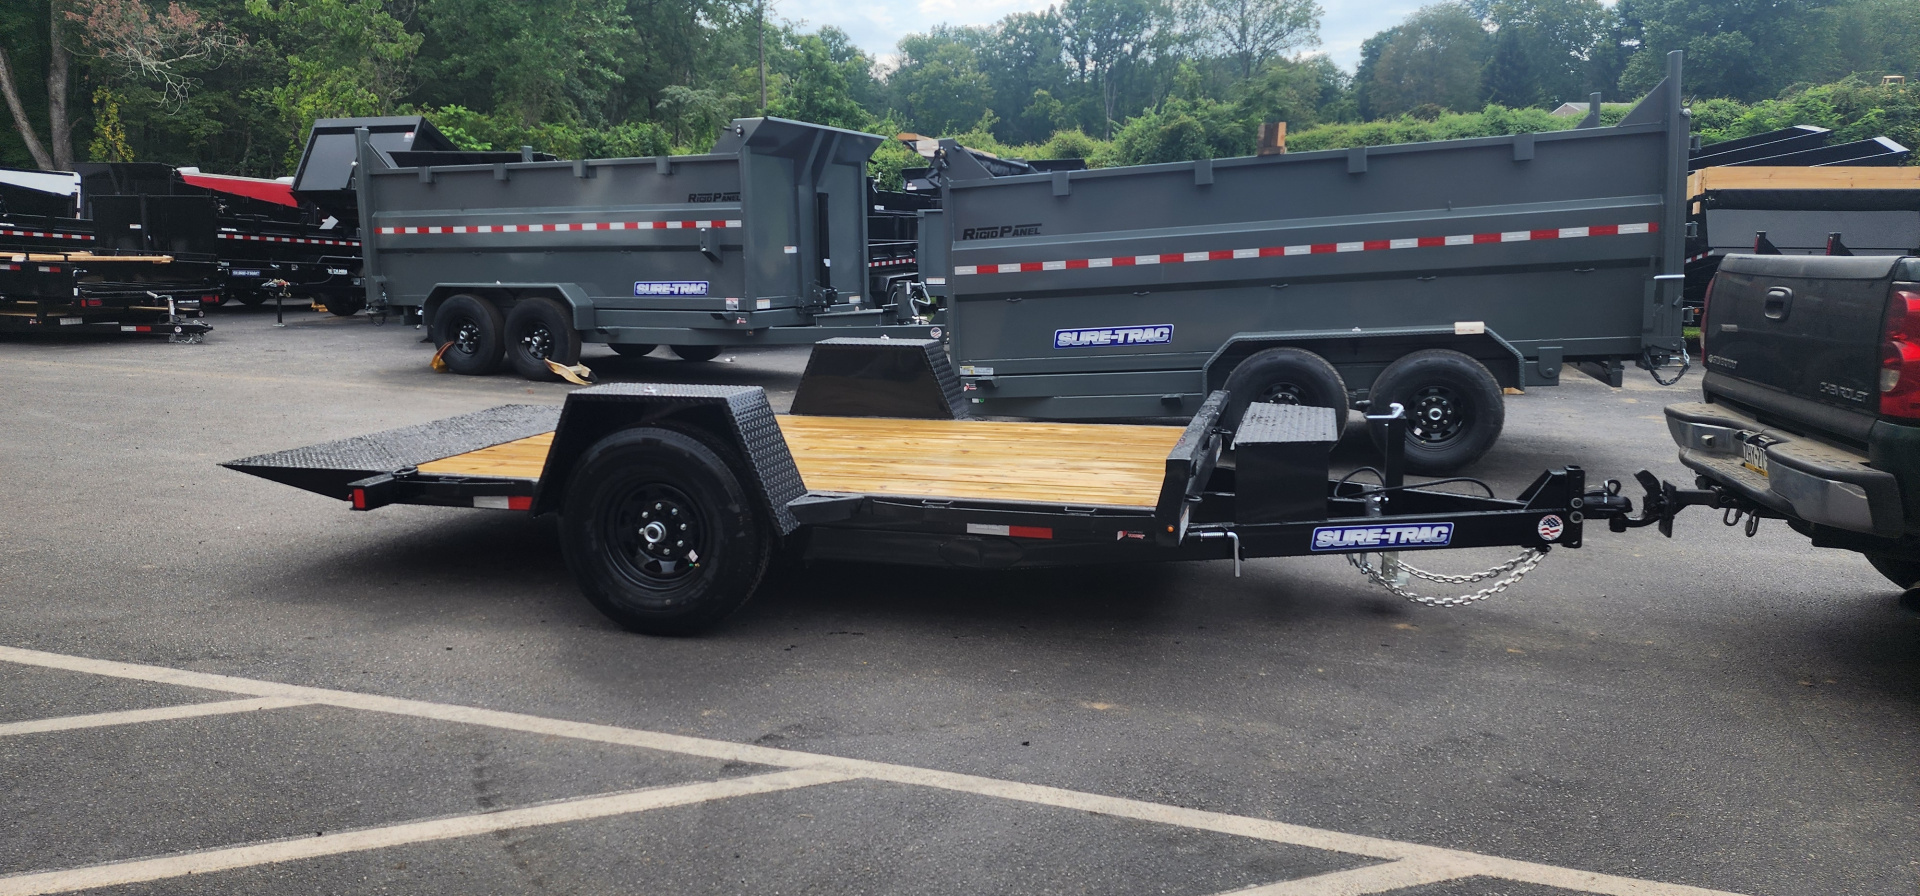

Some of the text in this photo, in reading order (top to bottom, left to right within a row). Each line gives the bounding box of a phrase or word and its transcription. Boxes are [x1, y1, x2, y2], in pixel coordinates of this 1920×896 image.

[963, 223, 1042, 240] RIGID PANEL
[636, 283, 707, 295] SURE-TRAC
[1057, 327, 1170, 347] SURE-TRAC
[1315, 526, 1449, 547] SURE-TRAC
